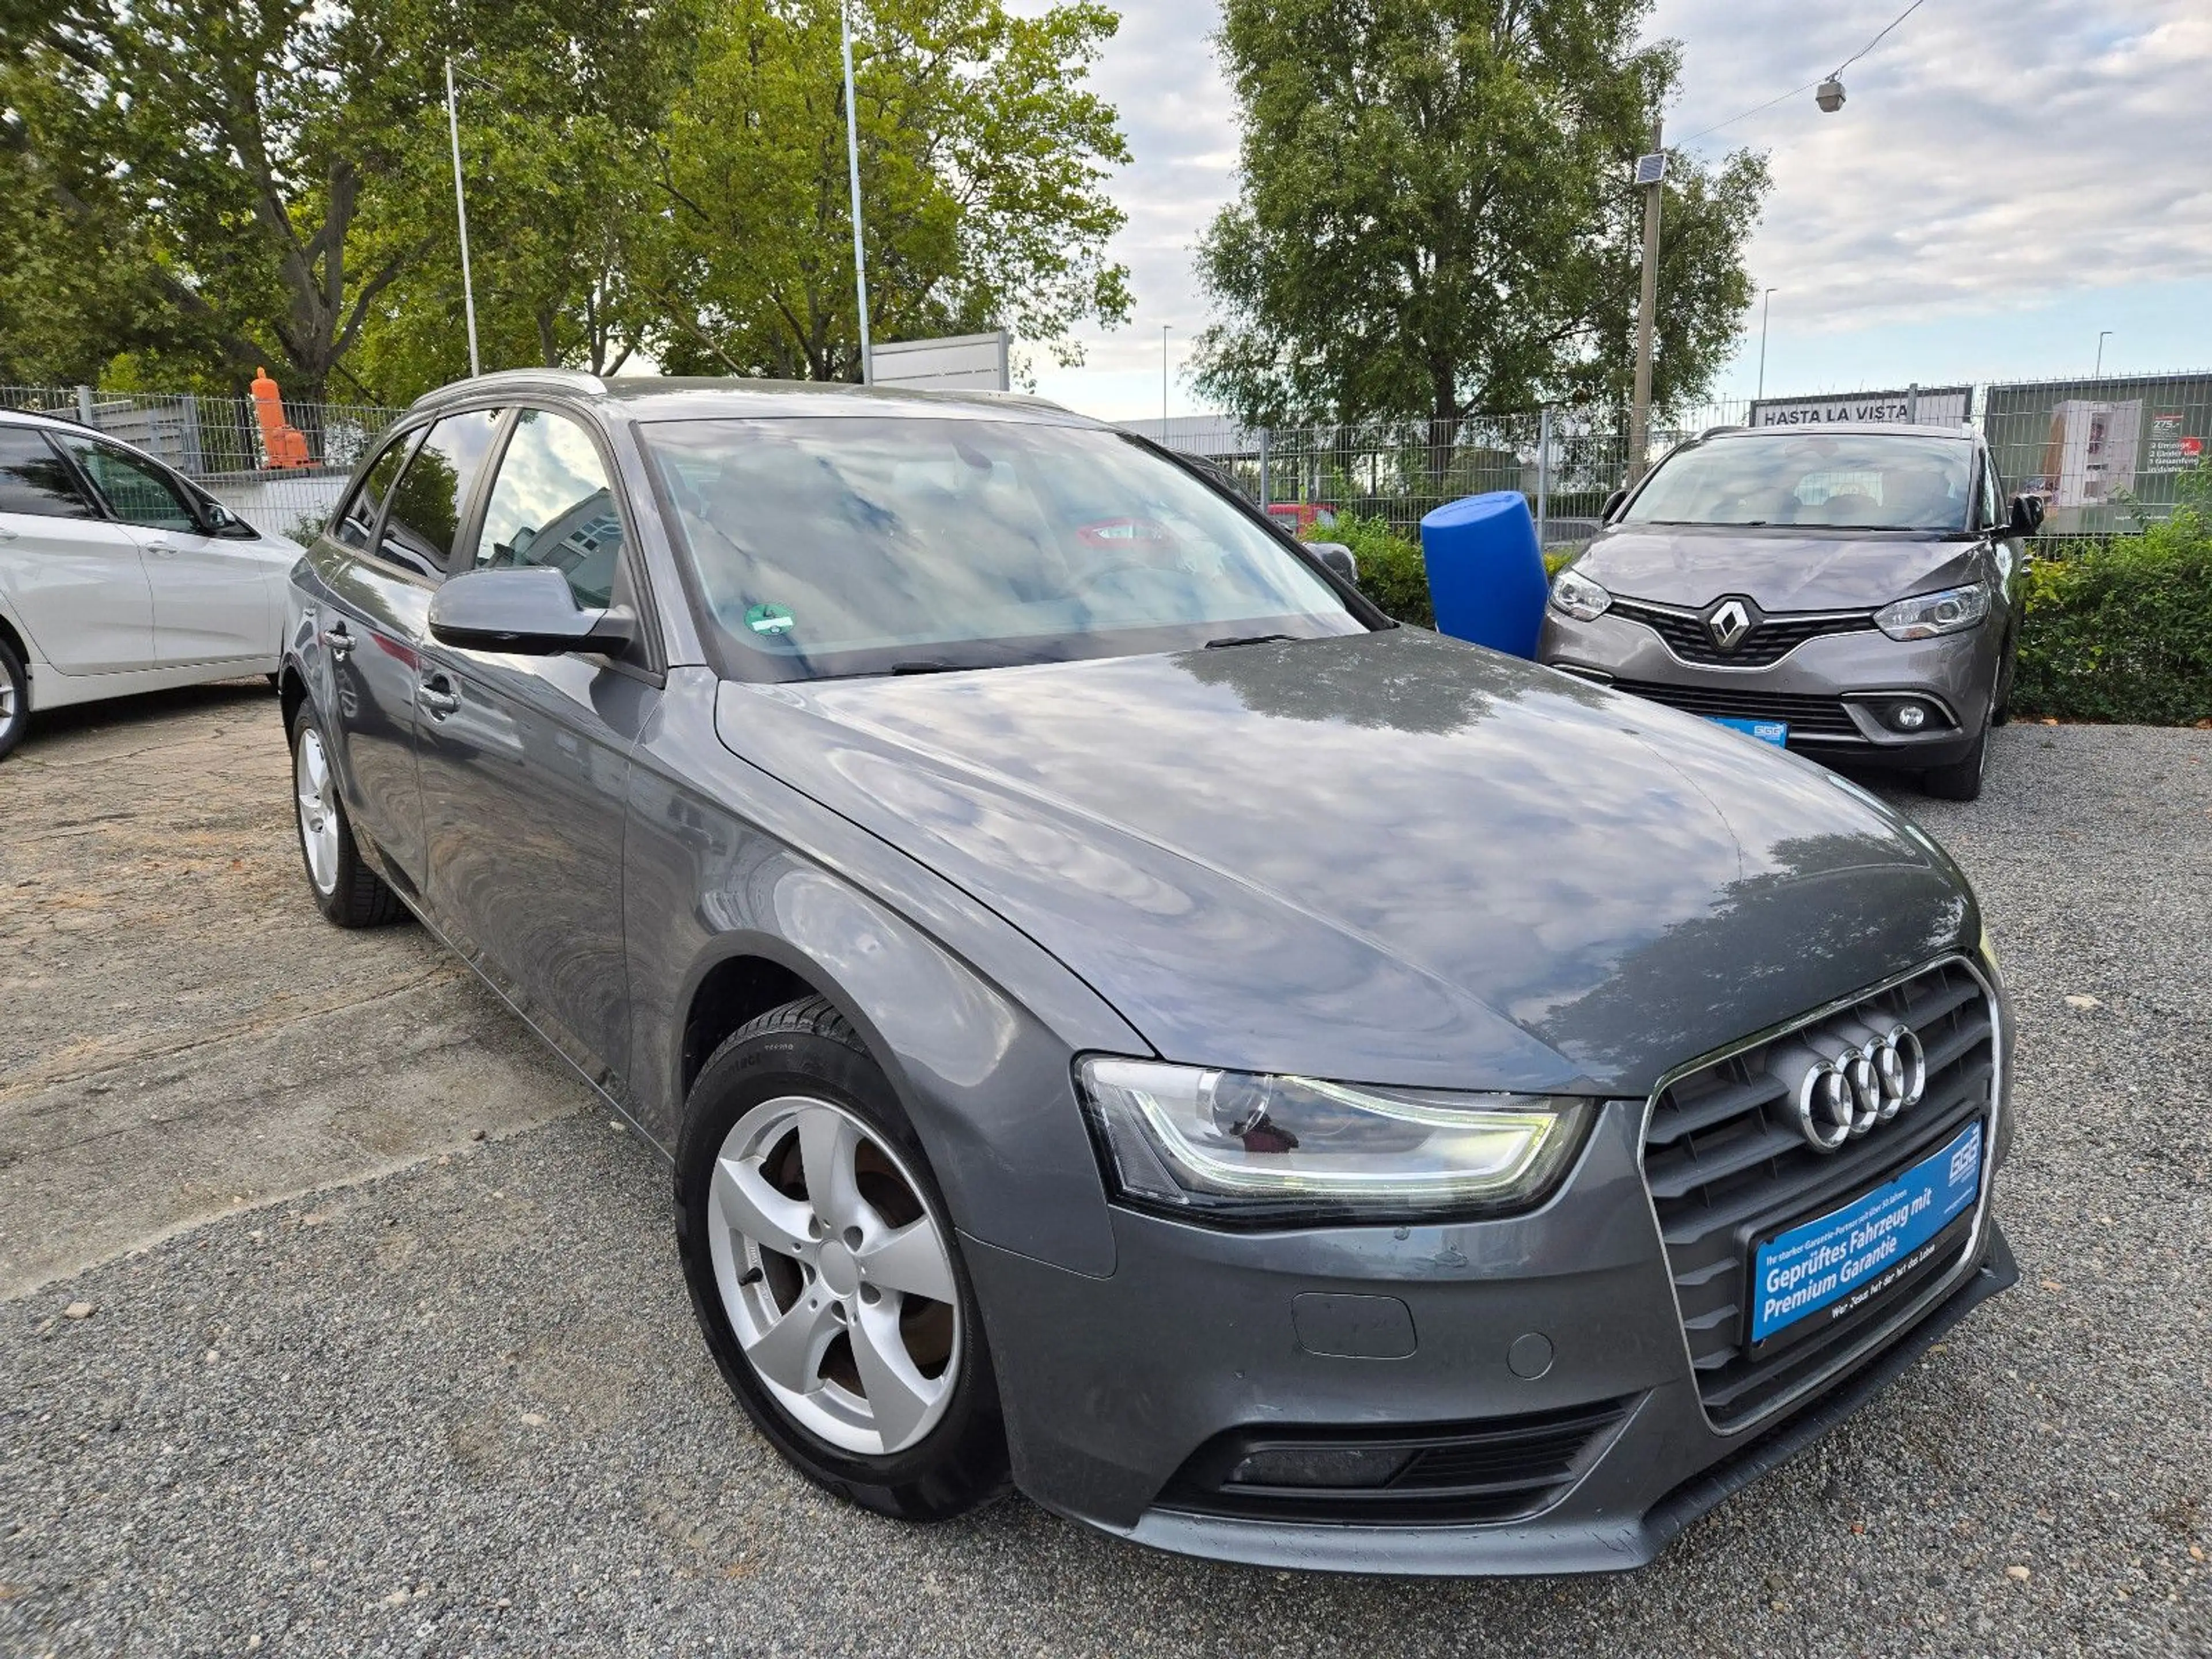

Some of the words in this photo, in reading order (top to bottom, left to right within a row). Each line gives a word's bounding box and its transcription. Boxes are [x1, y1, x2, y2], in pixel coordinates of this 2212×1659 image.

[1764, 410, 1821, 426] HASTA
[1827, 407, 1849, 421] LA
[1856, 404, 1908, 421] VISTA
[1767, 1241, 1847, 1293] Geprüftes
[1850, 1204, 1909, 1253] Fahrzeug
[1910, 1187, 1932, 1216] mit
[1766, 1256, 1777, 1266] Ihr
[1764, 1273, 1837, 1323] Premium
[1840, 1235, 1897, 1282] Garantie
[1831, 1304, 1848, 1319] Wer
